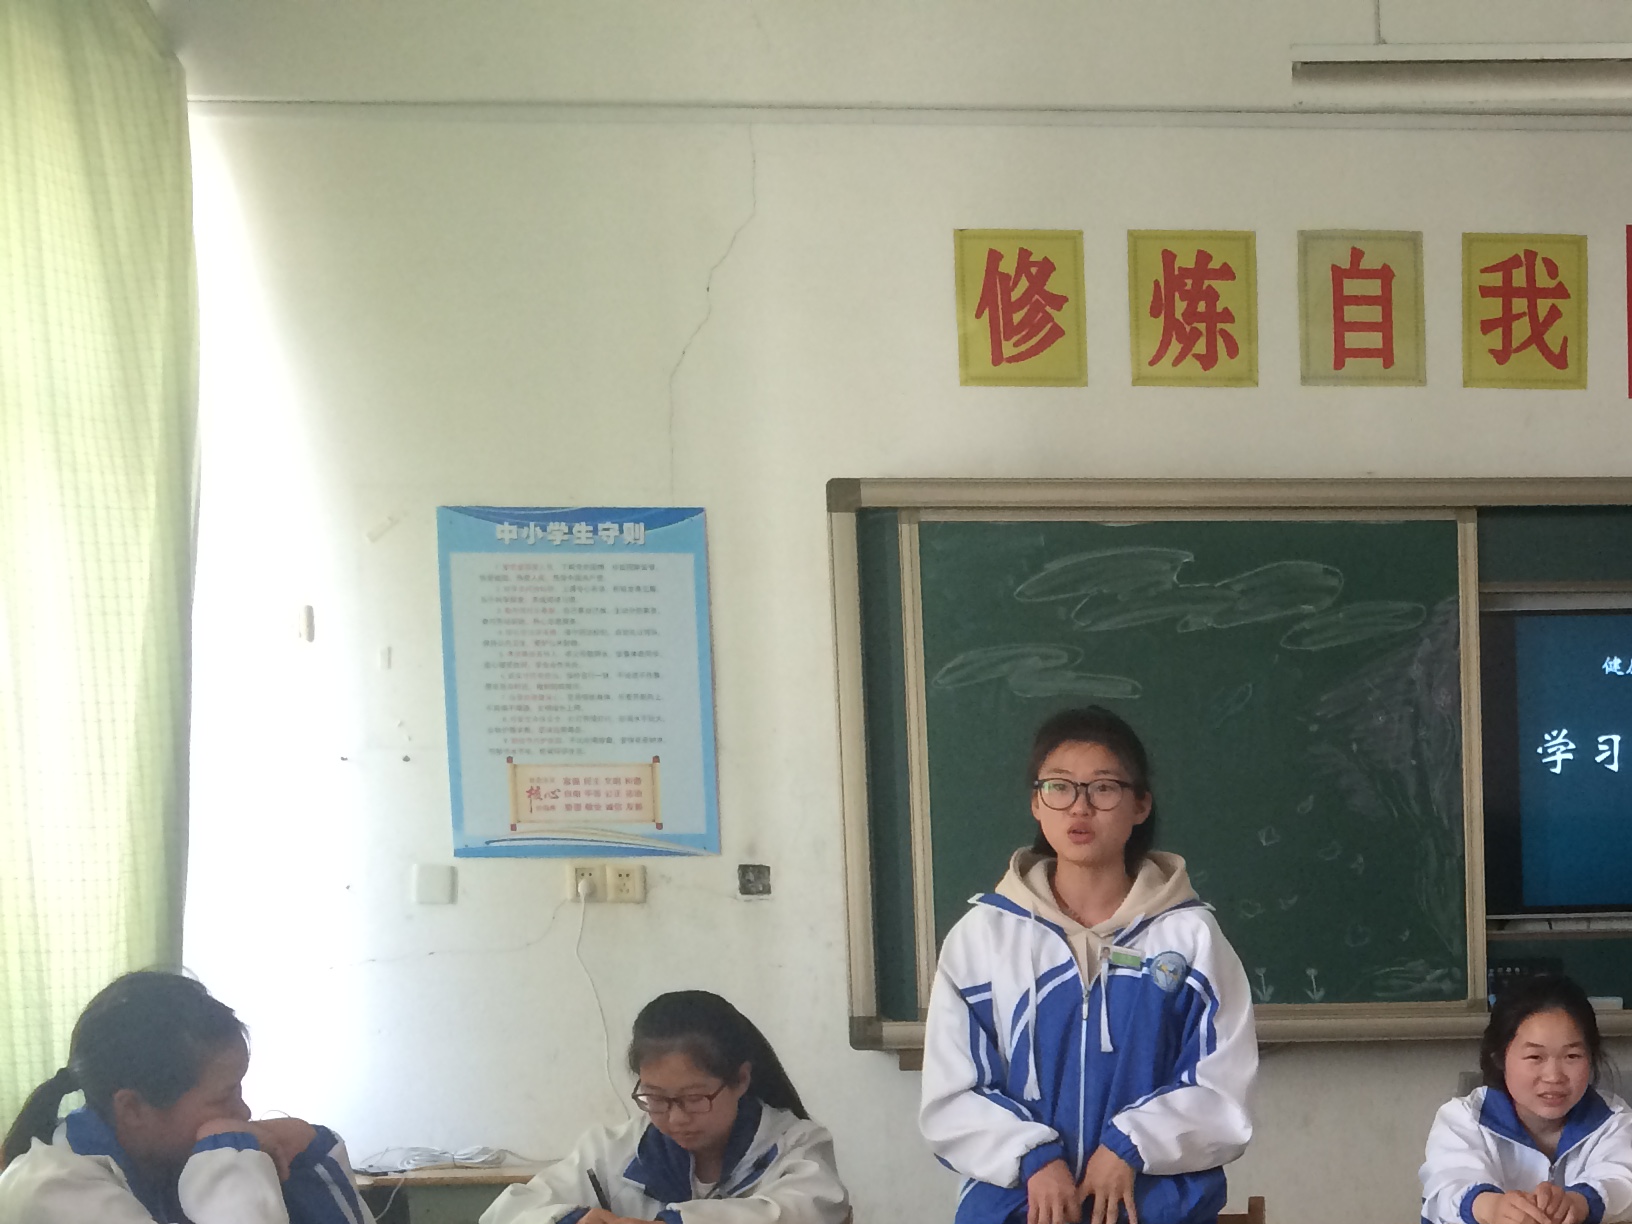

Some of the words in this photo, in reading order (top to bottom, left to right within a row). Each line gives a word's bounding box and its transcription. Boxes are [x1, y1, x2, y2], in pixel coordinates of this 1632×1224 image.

[973, 246, 1571, 371] 修炼自我
[495, 521, 646, 546] 中小学生守则
